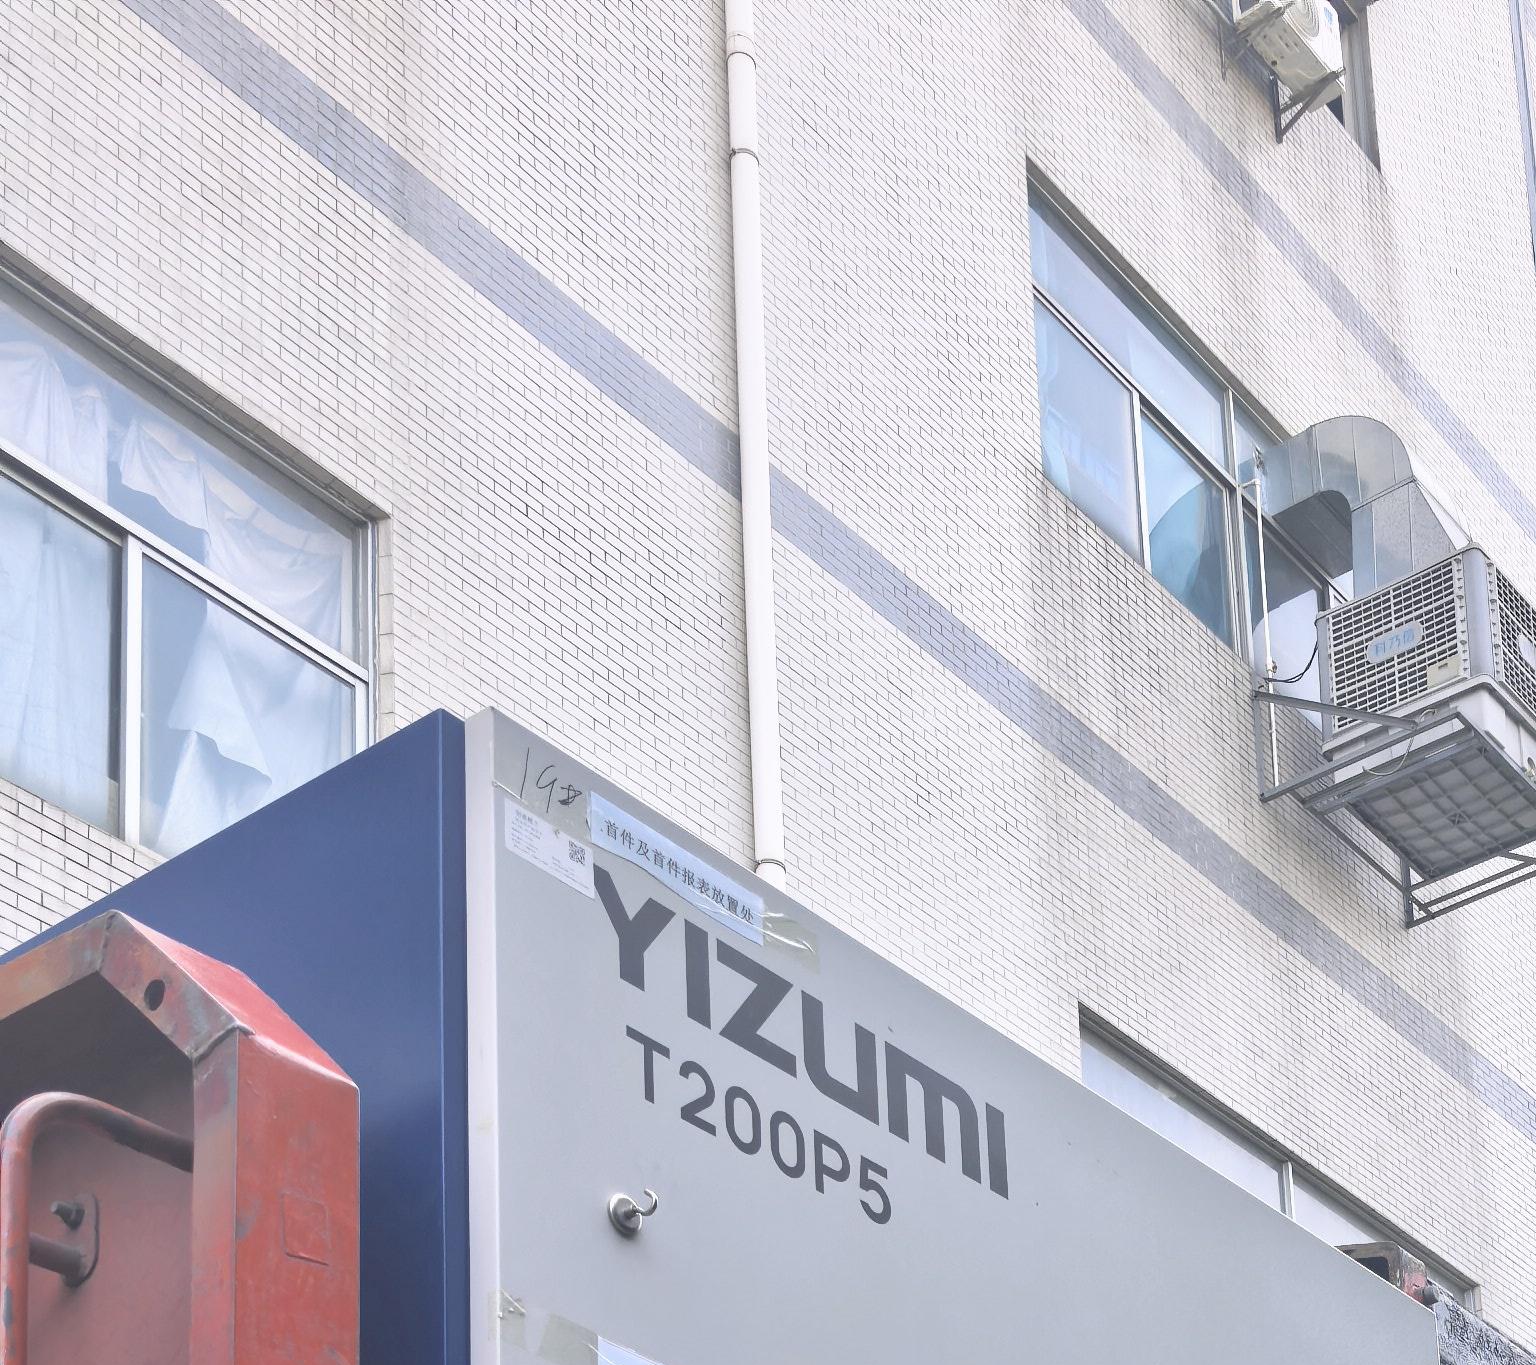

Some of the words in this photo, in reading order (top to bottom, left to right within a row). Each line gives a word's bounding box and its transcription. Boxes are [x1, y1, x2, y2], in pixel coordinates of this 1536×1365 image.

[603, 818, 754, 925] 首件及首件报表放置处
[593, 863, 1009, 1200] YIZUMI
[626, 1025, 892, 1225] T200P5
